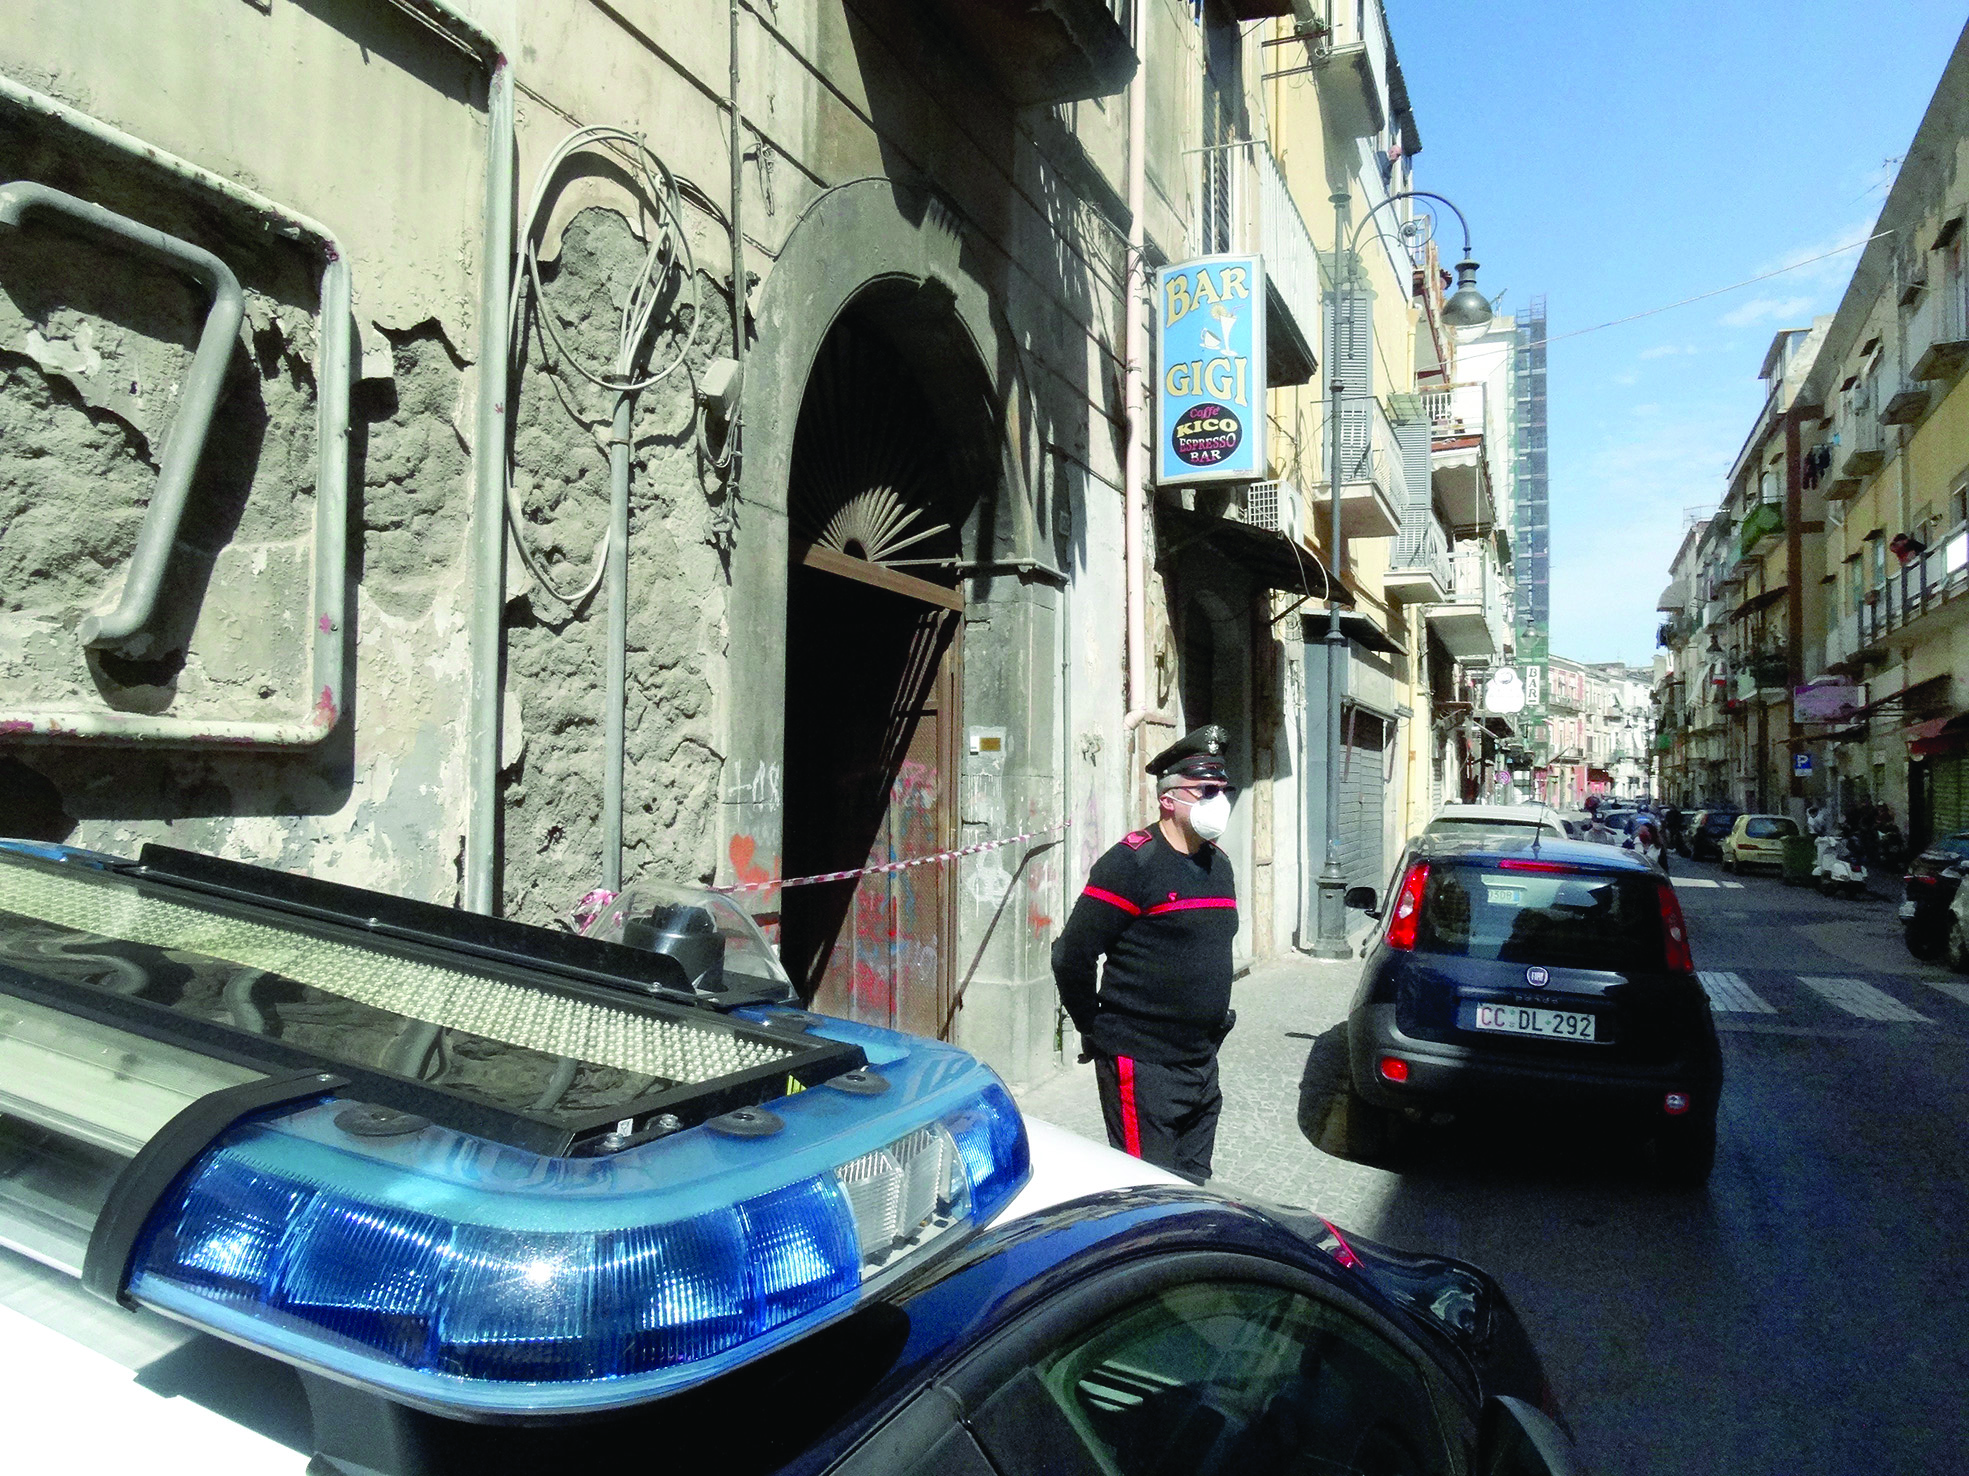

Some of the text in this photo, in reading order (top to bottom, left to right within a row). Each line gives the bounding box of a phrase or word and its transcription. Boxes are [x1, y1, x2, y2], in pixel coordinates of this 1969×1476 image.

[1166, 267, 1249, 328] BAR
[1166, 357, 1248, 407] GIGI
[1176, 418, 1238, 438] KICO
[1179, 432, 1237, 453] ESPRESSO
[1190, 449, 1222, 463] BAR
[1528, 668, 1537, 698] BAR
[1797, 755, 1809, 767] P
[1481, 1006, 1591, 1037] CC DL 292
